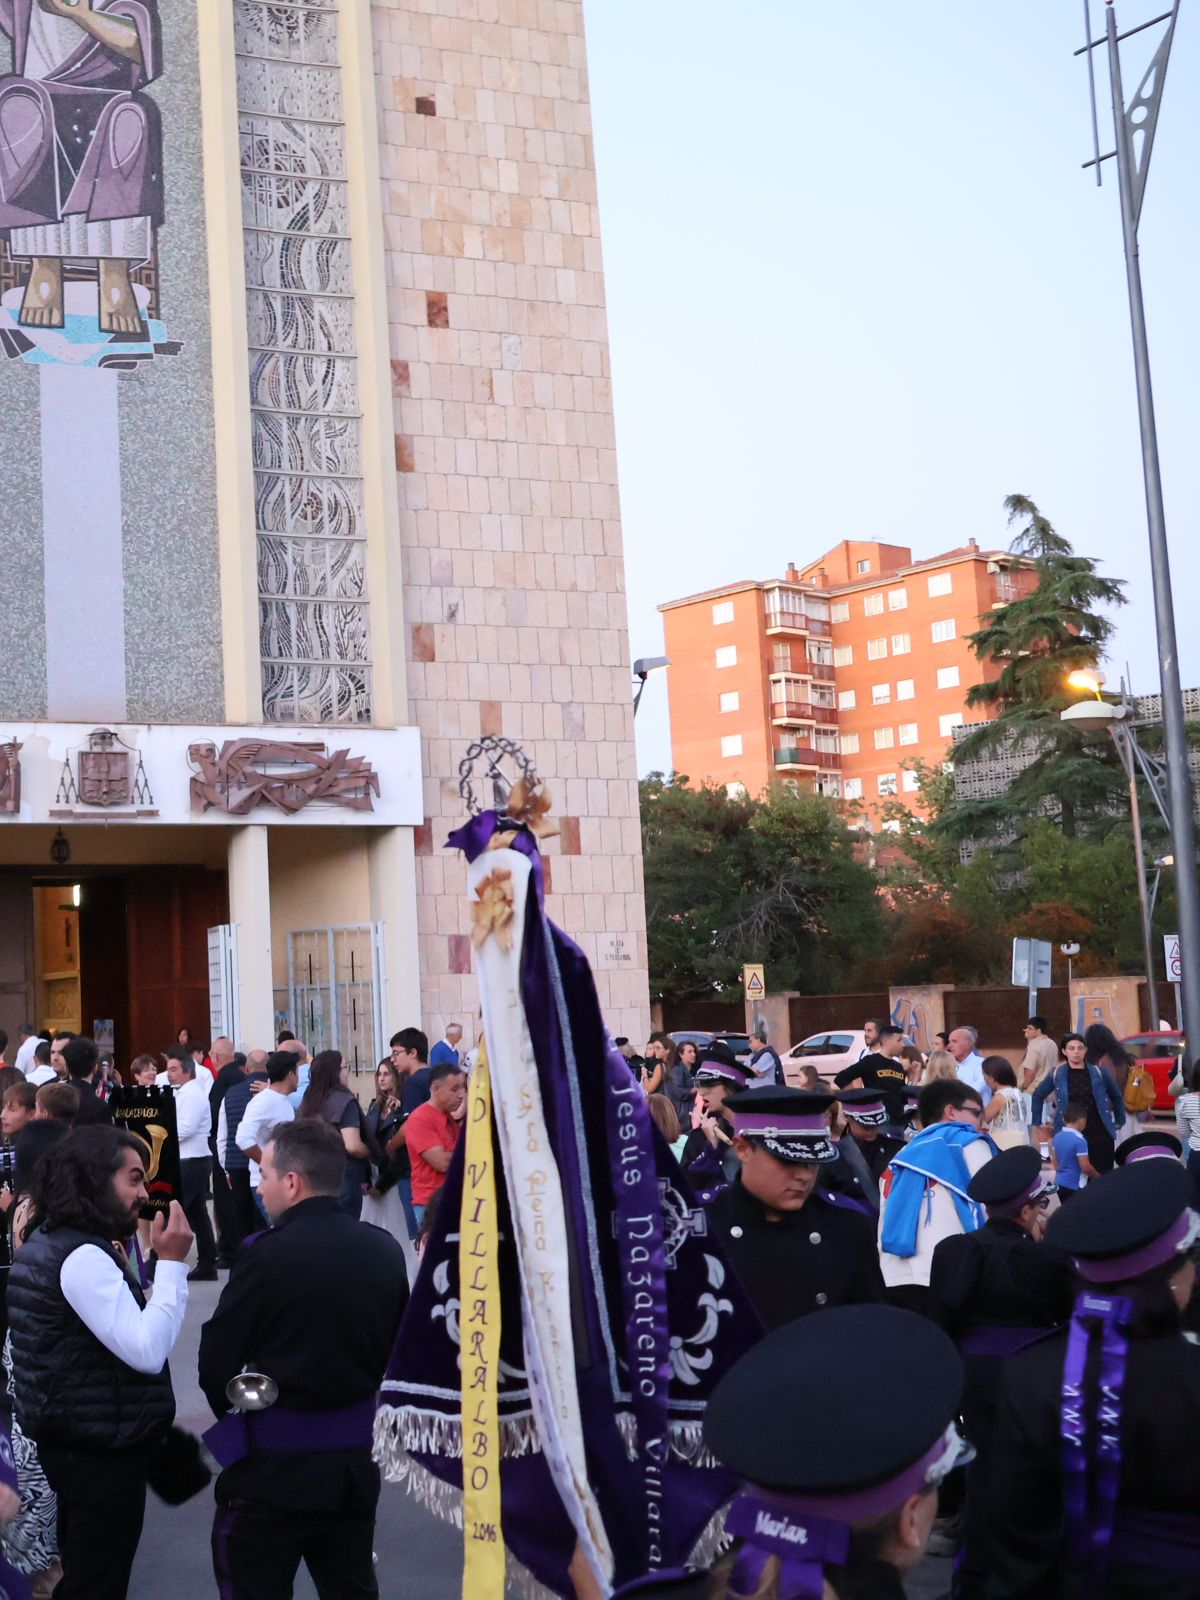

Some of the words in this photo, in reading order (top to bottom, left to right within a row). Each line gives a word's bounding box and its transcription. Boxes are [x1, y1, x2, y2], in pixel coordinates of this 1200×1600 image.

[611, 1085, 646, 1186] Jesús
[467, 1160, 490, 1491] VILLARALBO
[473, 1521, 497, 1543] 2016
